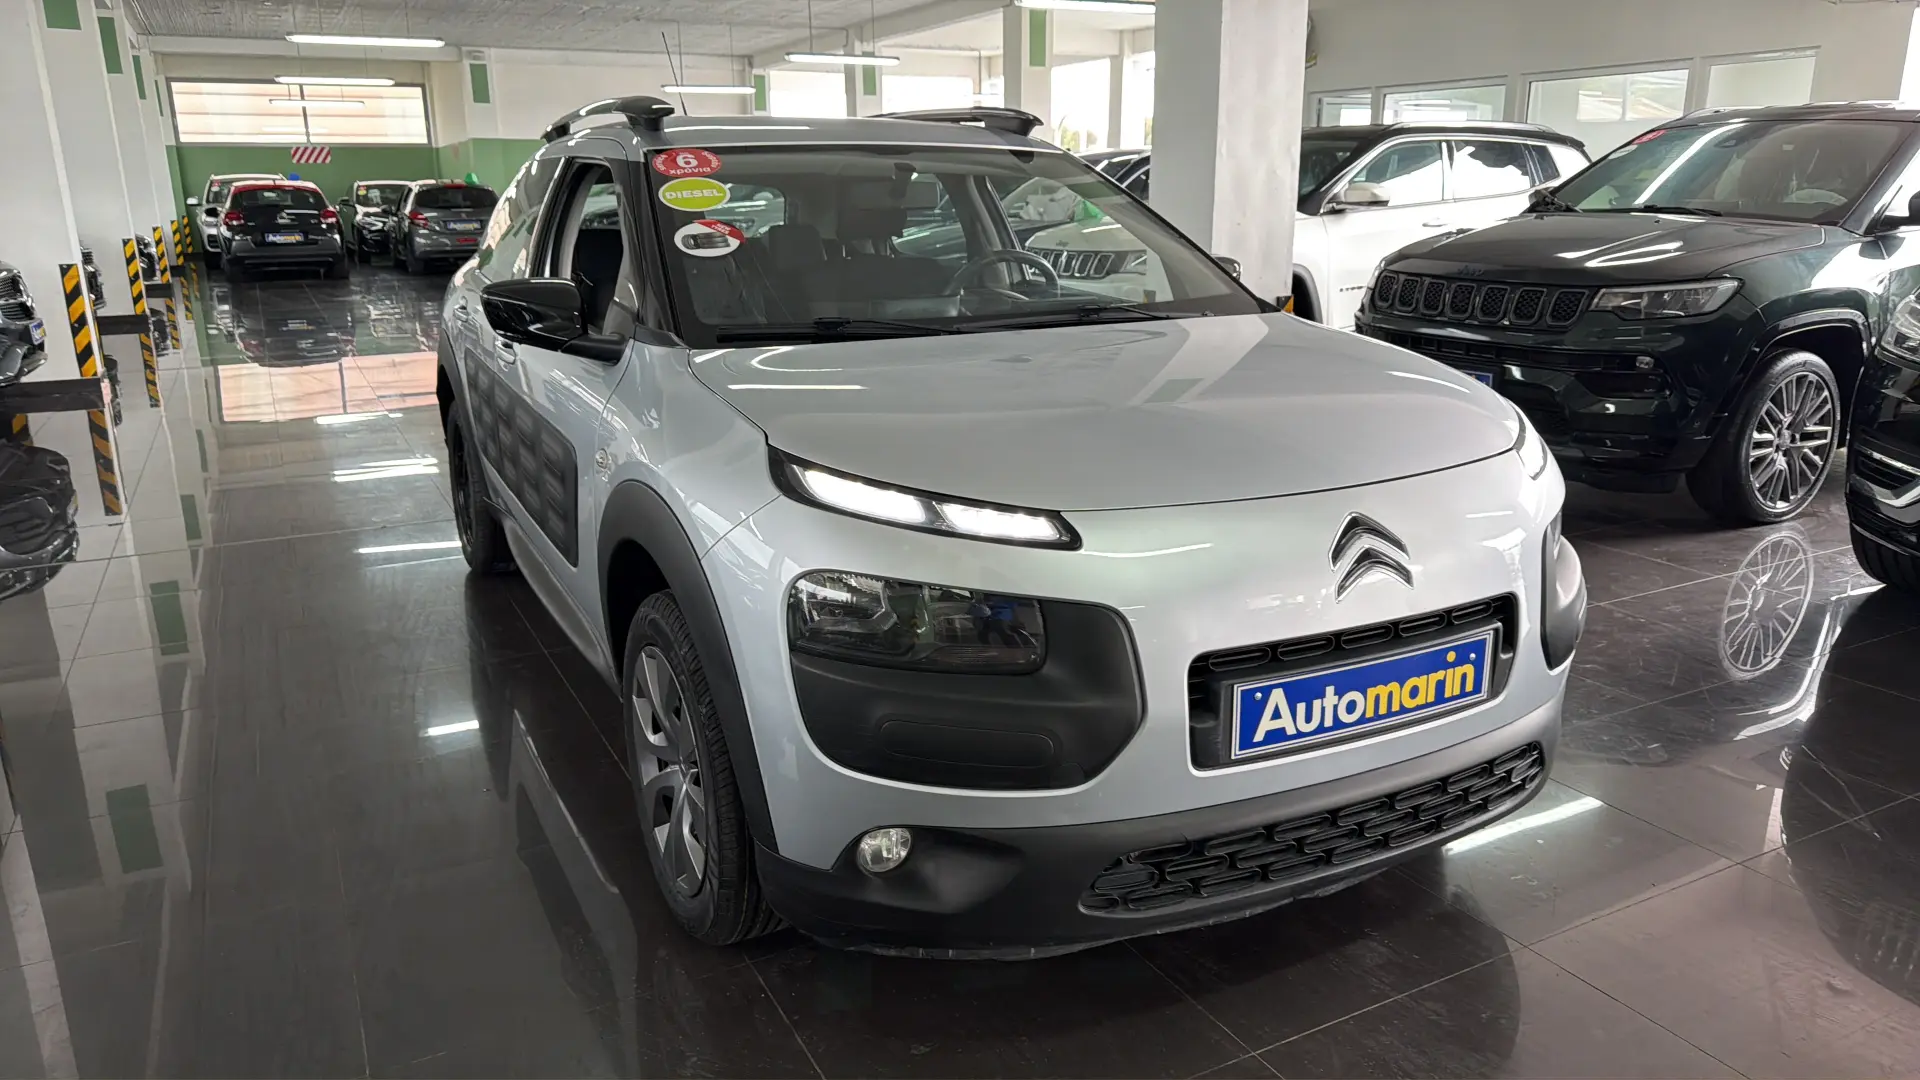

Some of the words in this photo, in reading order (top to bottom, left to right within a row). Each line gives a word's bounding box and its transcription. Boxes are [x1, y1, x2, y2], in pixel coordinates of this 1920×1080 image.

[676, 153, 698, 168] 6
[669, 166, 711, 175] χρόνια
[665, 189, 723, 199] DIESEL
[1253, 651, 1475, 743] Automarin
